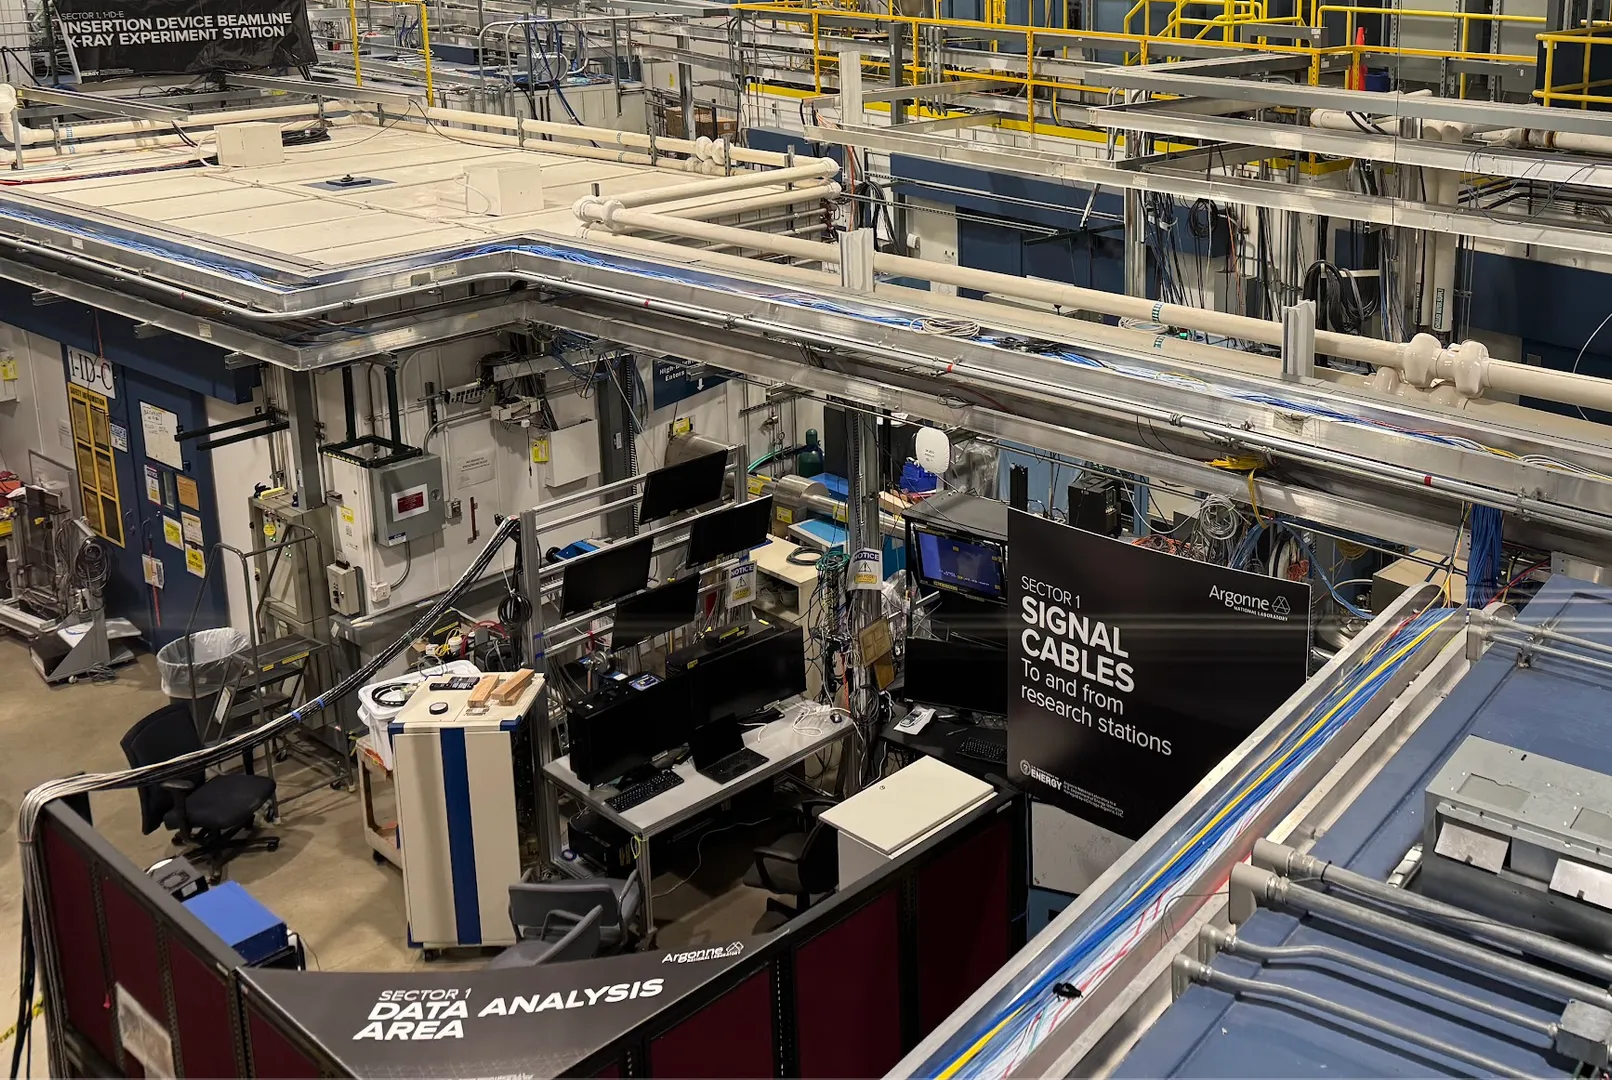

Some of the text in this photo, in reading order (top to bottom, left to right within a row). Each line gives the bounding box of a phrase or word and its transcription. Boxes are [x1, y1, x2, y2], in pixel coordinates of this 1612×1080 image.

[61, 12, 94, 20] SECTOR
[64, 12, 292, 34] INSERTION DEVICE BEAMLINE
[68, 25, 285, 48] X-RAY EXPERIMENT STATION
[69, 350, 113, 391] 1-ID-C
[854, 552, 880, 560] NOTICE
[731, 564, 754, 577] NOTICE
[1021, 576, 1080, 609] SECTOR 1
[1208, 584, 1270, 612] Argonne
[1233, 605, 1288, 622] NATIONAL LABORATORY
[1021, 595, 1129, 659] SIGNAL
[1021, 628, 1135, 693] CABLES
[1021, 657, 1124, 716] To and from
[1021, 684, 1172, 756] research stations
[1030, 768, 1062, 790] ENERGY
[662, 946, 724, 964] Argonne
[368, 978, 664, 1020] DATA ANALYSIS
[378, 988, 472, 1001] SECTOR 1
[352, 1020, 464, 1040] AREA
